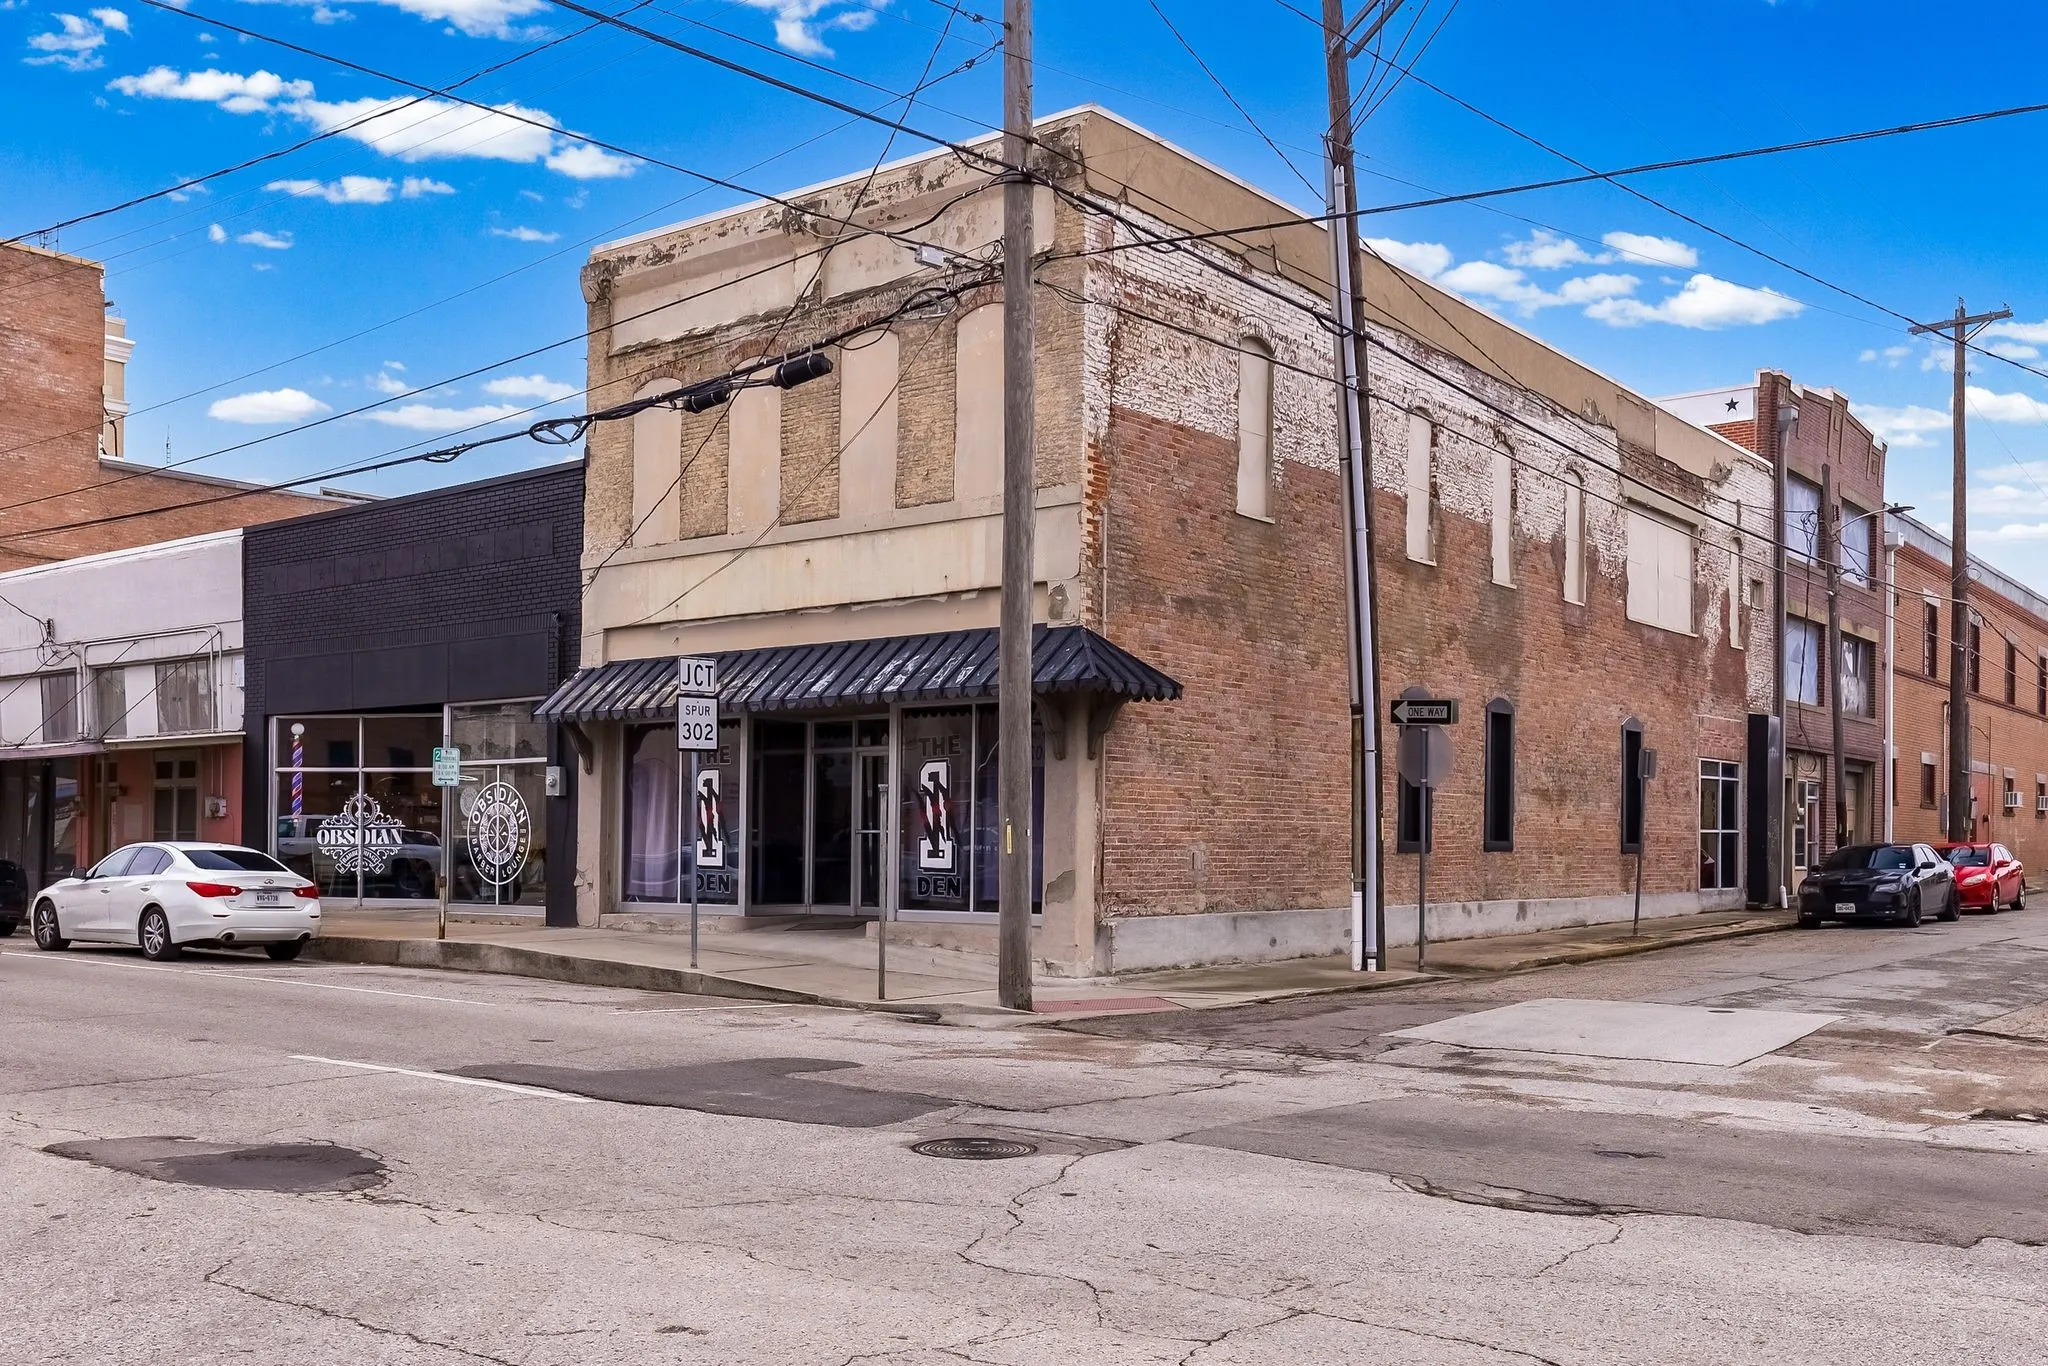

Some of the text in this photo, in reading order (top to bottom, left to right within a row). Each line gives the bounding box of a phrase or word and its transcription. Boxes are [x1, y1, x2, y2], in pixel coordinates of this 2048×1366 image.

[682, 663, 714, 687] JCT
[685, 704, 711, 717] SPUR
[1408, 707, 1445, 717] ONE WAY
[682, 722, 714, 741] 302
[919, 735, 960, 757] THE
[472, 787, 527, 824] OBSIDIAN
[916, 876, 962, 898] DEN
